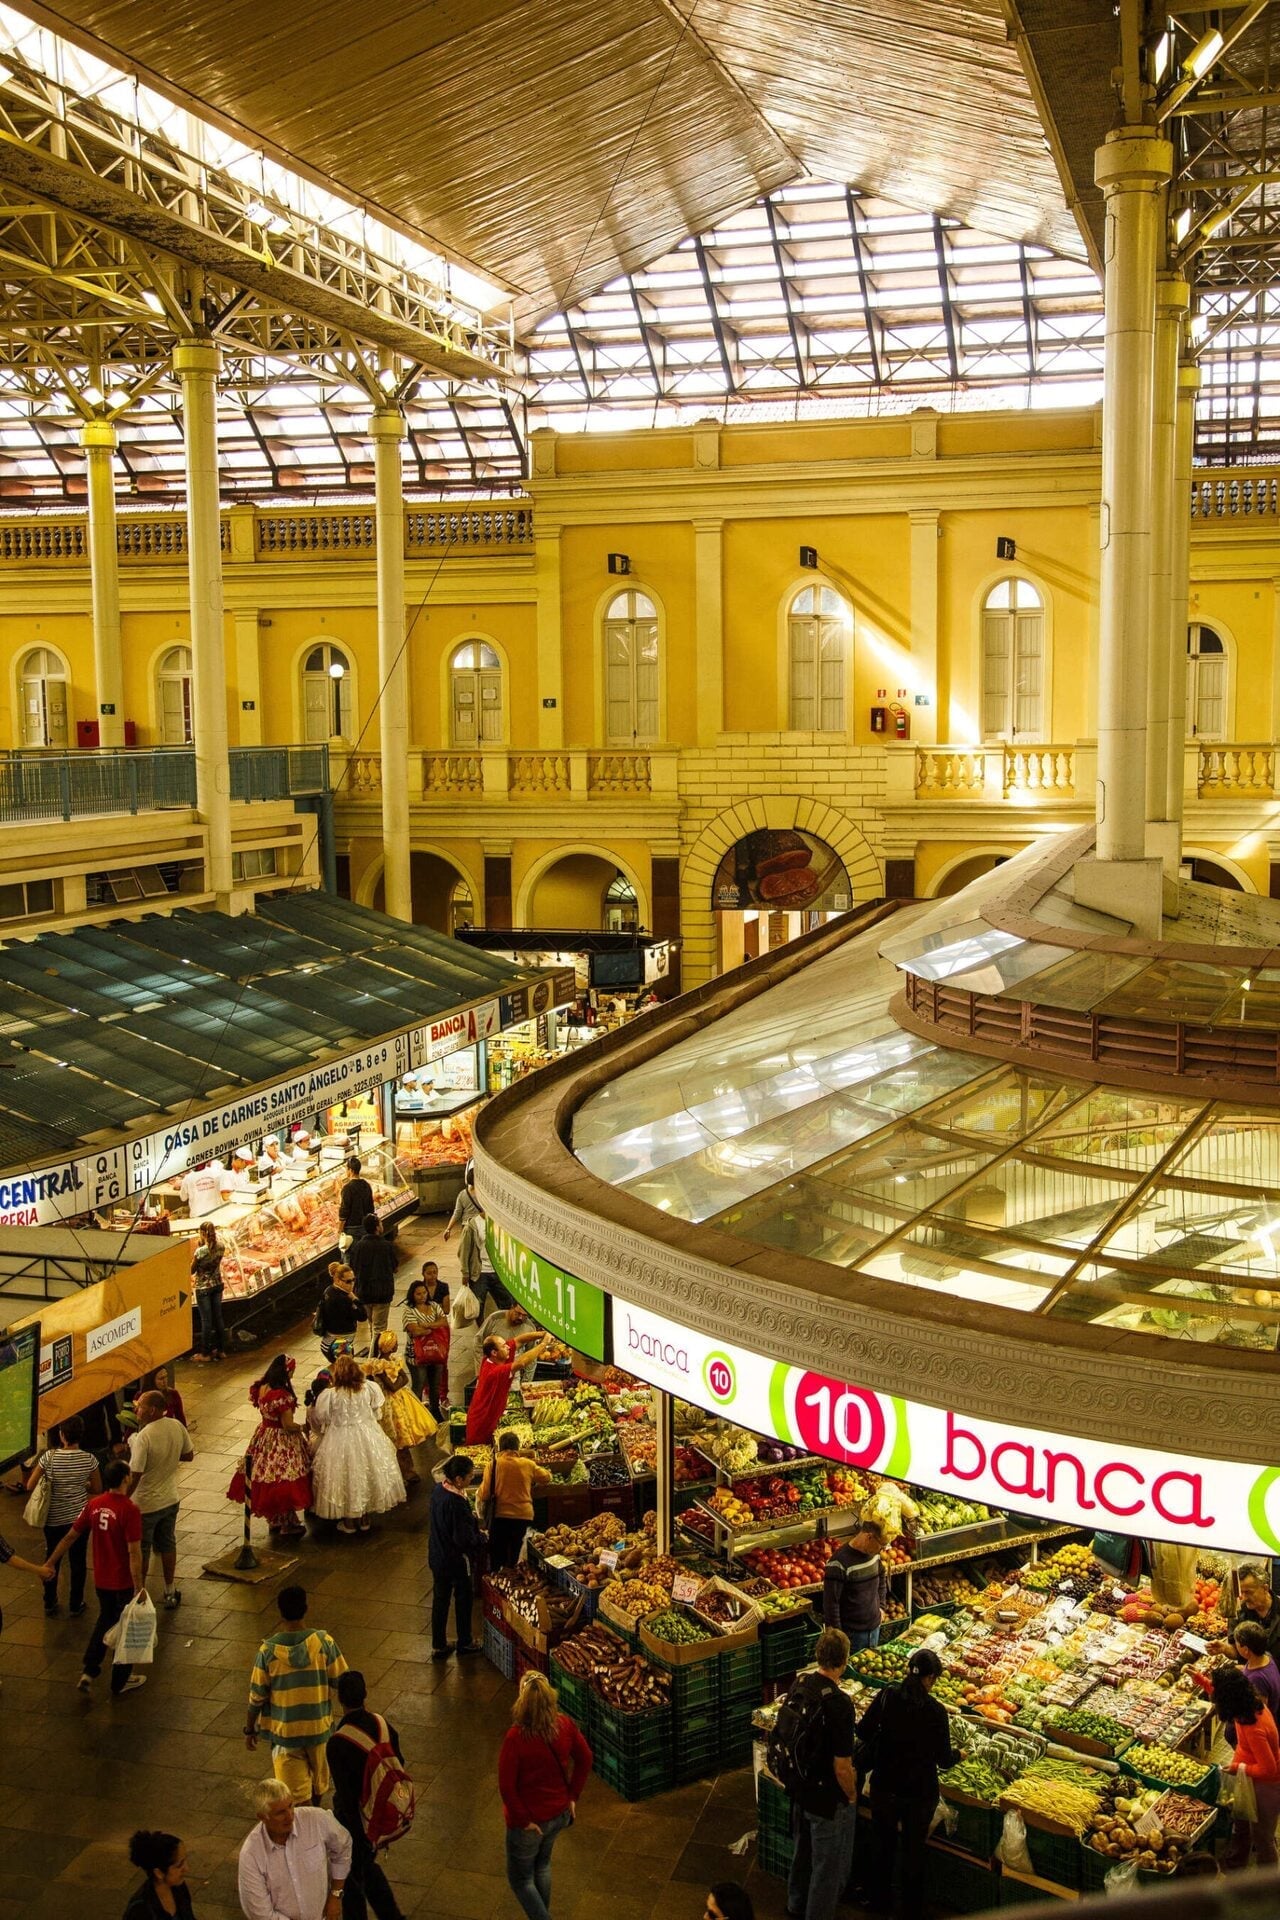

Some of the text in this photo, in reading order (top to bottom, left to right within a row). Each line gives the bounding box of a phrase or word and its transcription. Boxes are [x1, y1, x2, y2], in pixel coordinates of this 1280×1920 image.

[431, 1014, 466, 1042] BANCA
[467, 1010, 477, 1041] A
[164, 1124, 200, 1152] CASA
[202, 1115, 219, 1138] DE
[221, 1096, 268, 1129] CARNES
[270, 1080, 306, 1110] SANTO
[308, 1063, 347, 1094] ÂNGELO
[356, 1058, 365, 1074] B.
[366, 1054, 372, 1069] 8
[374, 1056, 380, 1065] e
[381, 1048, 387, 1062] 9
[186, 1147, 214, 1168] CARNES
[214, 1136, 240, 1155] BOVINA
[243, 1126, 263, 1143] OVINA
[286, 1116, 290, 1124] E
[292, 1109, 305, 1122] AVES
[306, 1105, 315, 1115] EM
[316, 1099, 333, 1111] GERAL
[0, 1165, 84, 1210] CENTRAL
[98, 1171, 117, 1184] BANCA
[493, 1221, 542, 1300] BANCA
[554, 1276, 577, 1321] 11
[90, 1317, 137, 1354] ASCOMEPC
[626, 1312, 691, 1375] banca
[711, 1368, 729, 1390] 10
[804, 1386, 872, 1454] 10
[940, 1411, 1216, 1528] banca
[99, 1512, 109, 1531] 5
